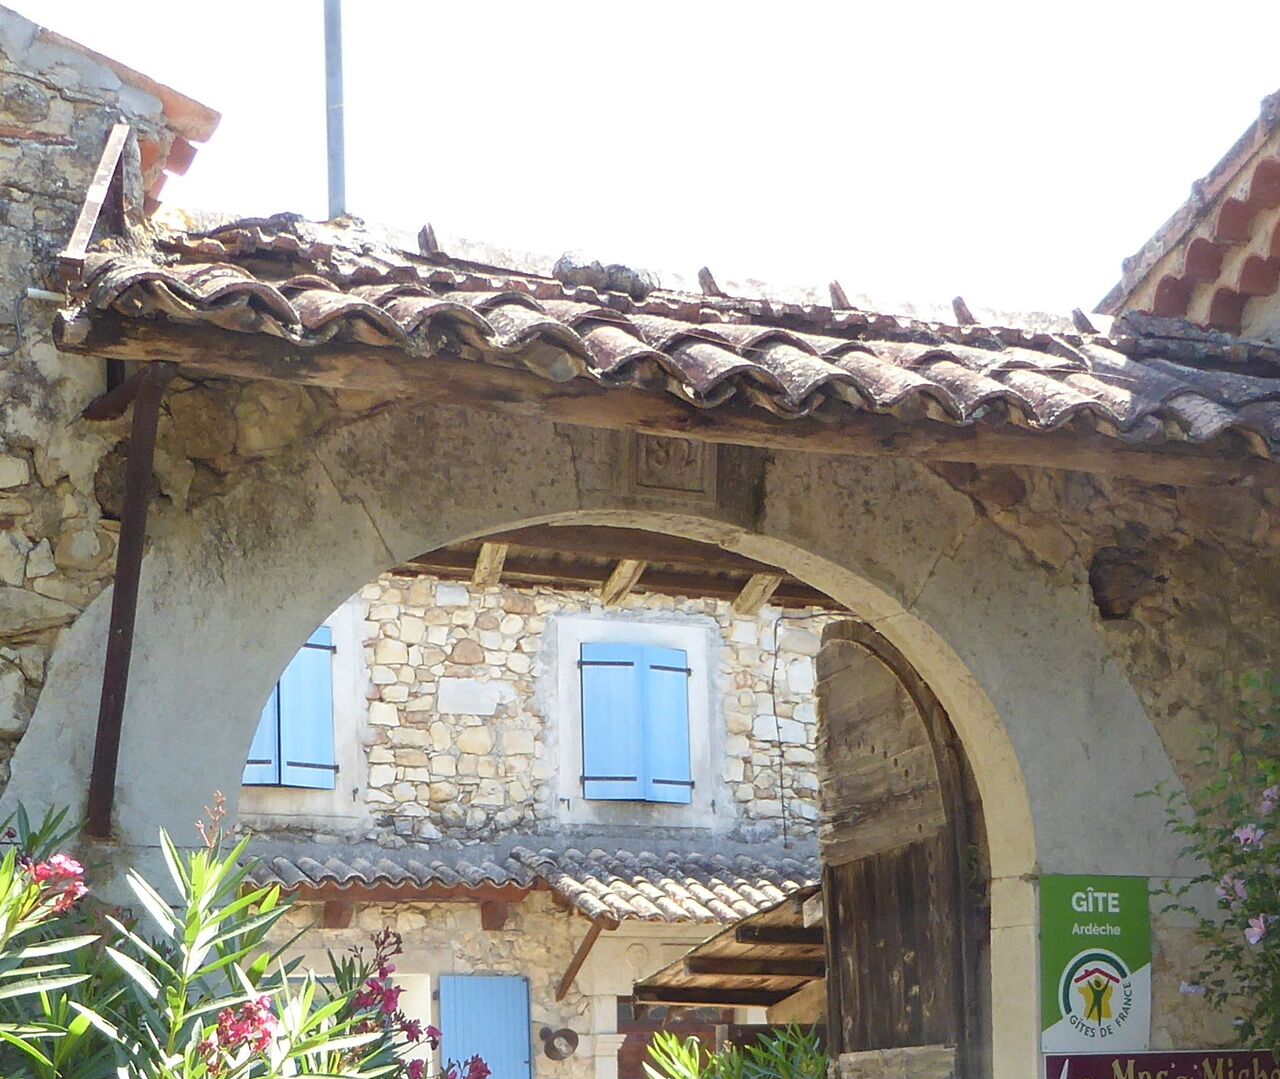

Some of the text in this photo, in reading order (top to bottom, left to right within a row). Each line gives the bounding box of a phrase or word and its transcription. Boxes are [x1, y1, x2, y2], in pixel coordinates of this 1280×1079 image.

[1072, 887, 1120, 913] GÎTE
[1072, 922, 1121, 935] Ardèche
[1069, 982, 1133, 1038] GÎTES DE FRANCE
